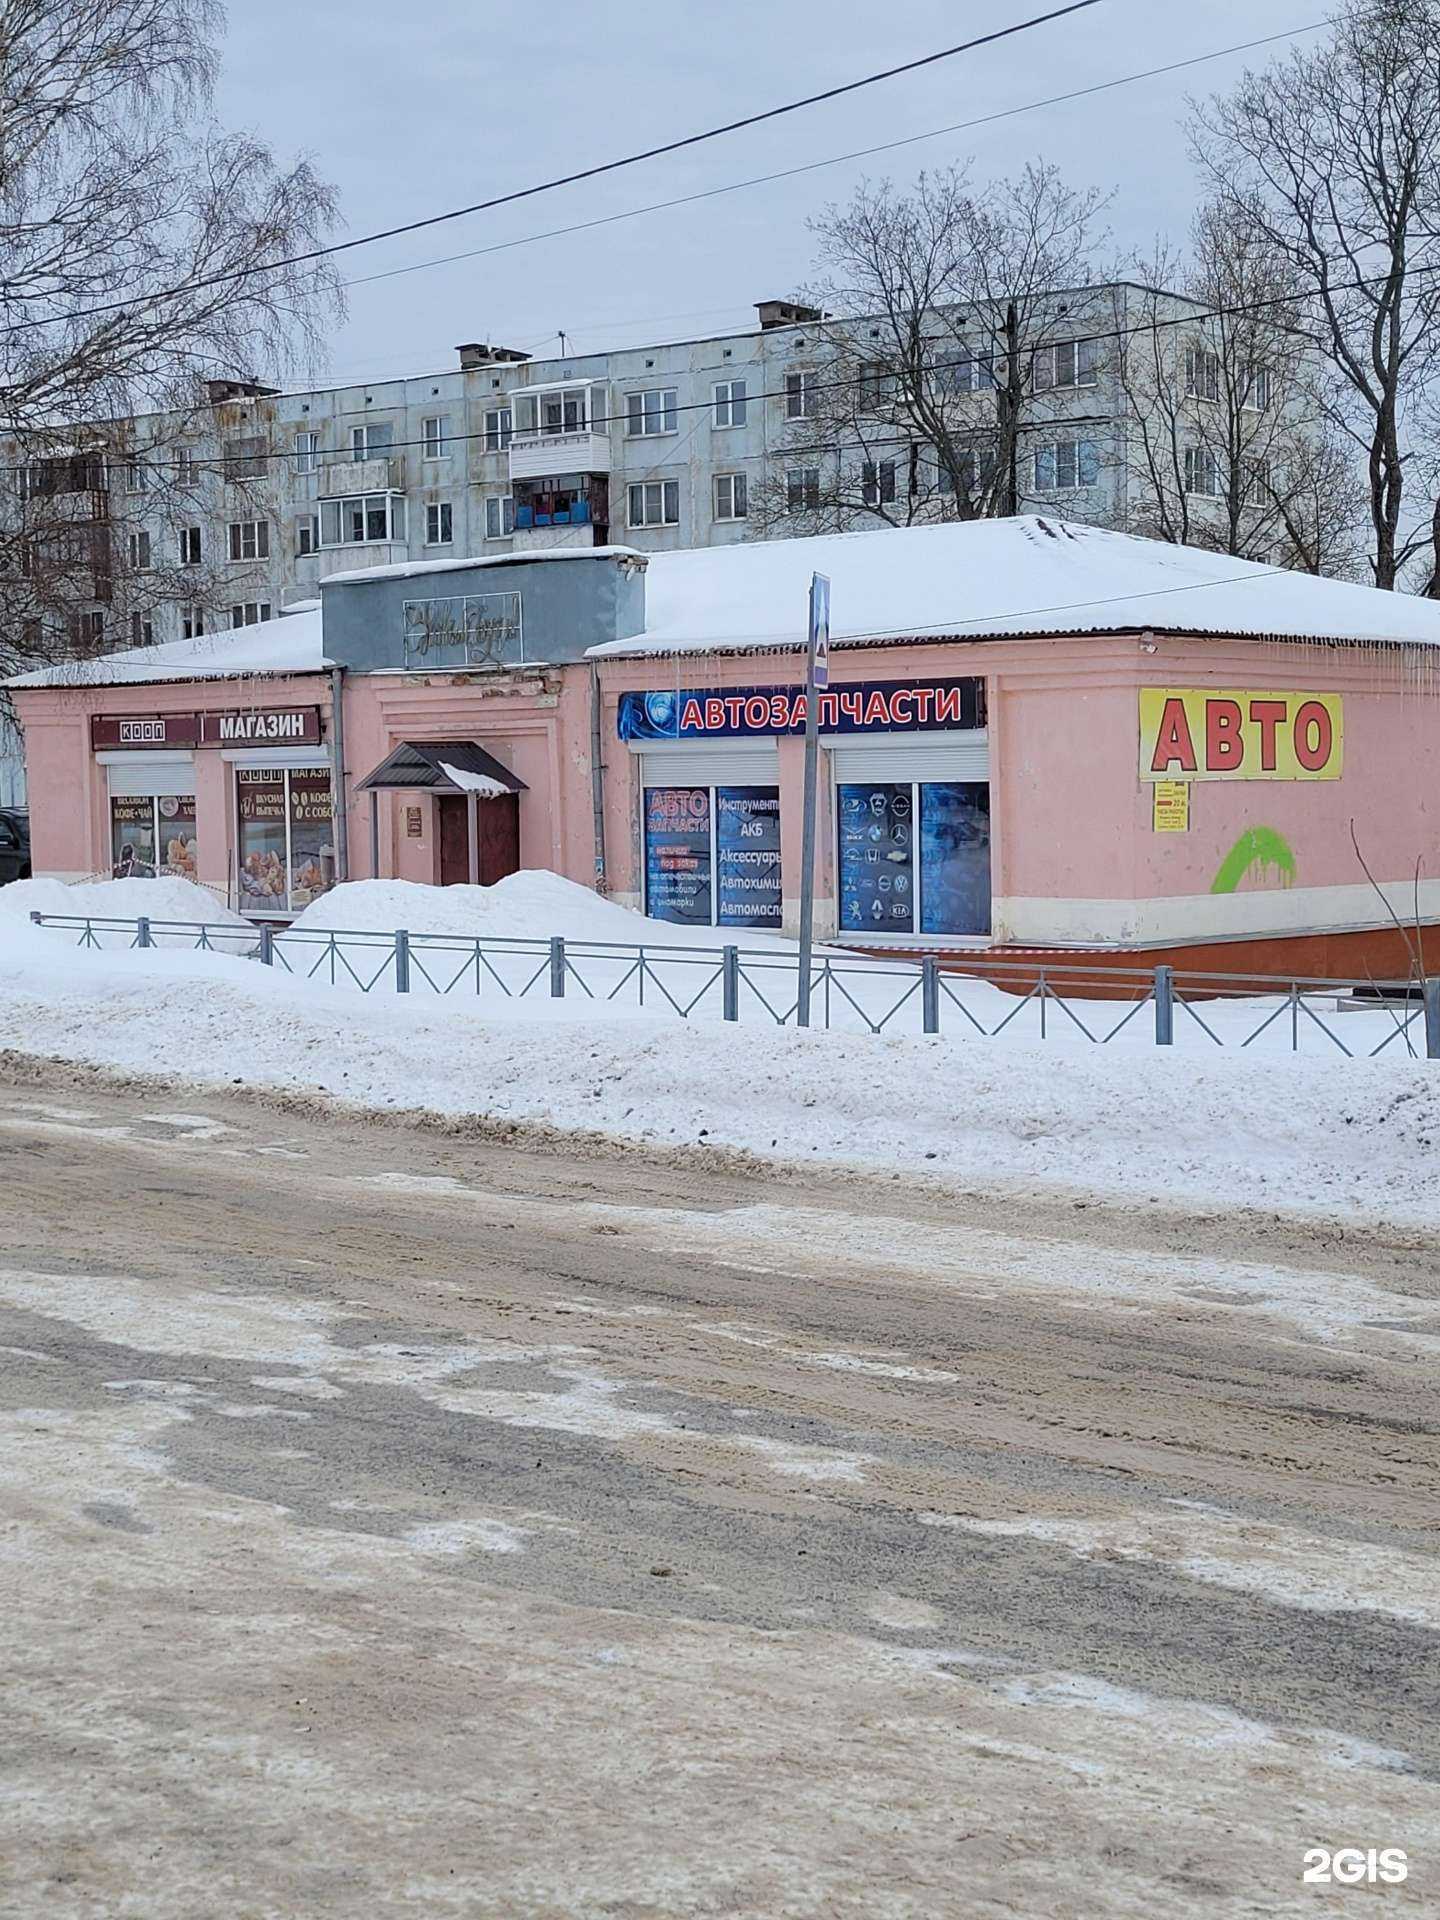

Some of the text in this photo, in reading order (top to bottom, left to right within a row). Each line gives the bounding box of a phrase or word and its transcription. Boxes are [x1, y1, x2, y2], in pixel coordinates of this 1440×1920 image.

[681, 687, 962, 729] АВТОЗАПЧАСТИ
[120, 721, 165, 741] КООП
[219, 714, 304, 740] МАГАЗИН
[1151, 698, 1332, 772] АВТО
[650, 790, 708, 817] АВТО
[648, 818, 710, 833] ЗАПЧАСТИ
[741, 822, 763, 837] АКБ
[720, 875, 782, 889] Автохими
